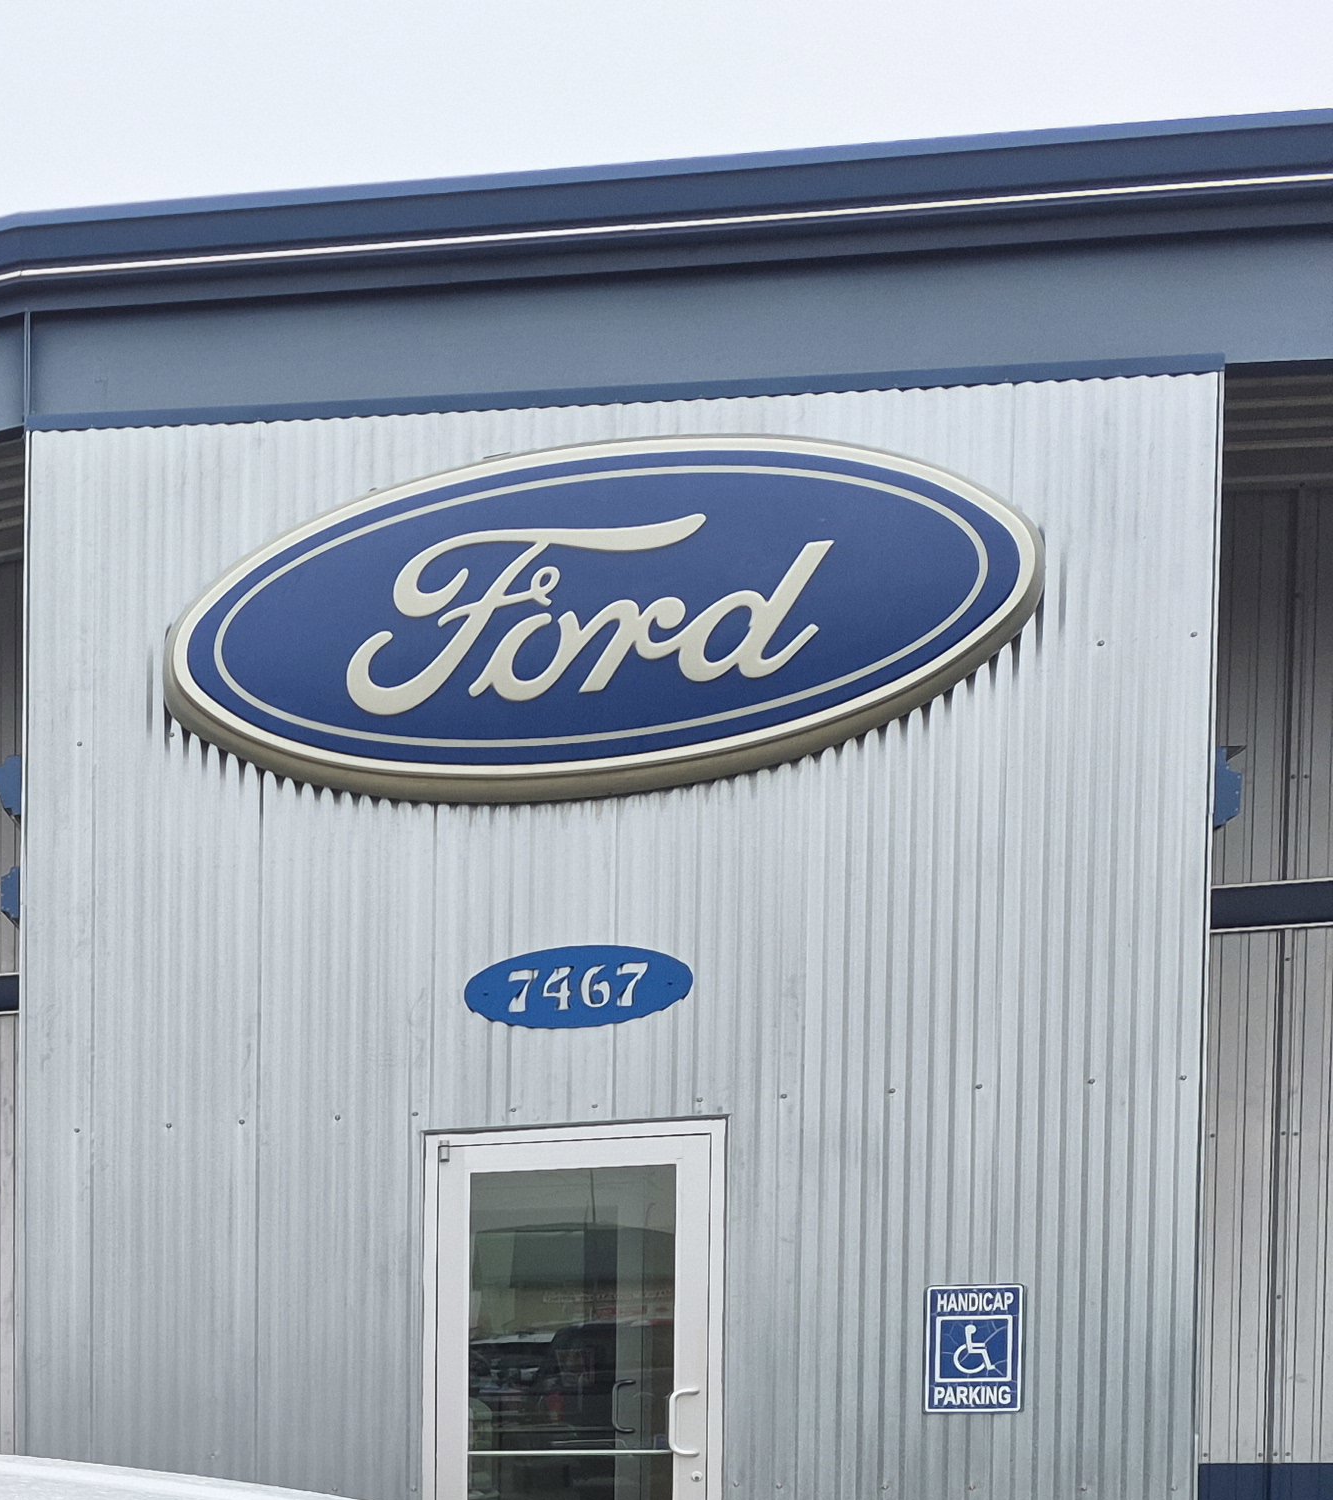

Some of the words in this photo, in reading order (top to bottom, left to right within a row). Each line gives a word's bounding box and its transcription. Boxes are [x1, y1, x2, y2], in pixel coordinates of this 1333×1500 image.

[346, 513, 835, 717] Ford
[507, 962, 650, 1012] 7467
[936, 1291, 1014, 1313] HANDICAP
[933, 1385, 1011, 1406] PARKING
